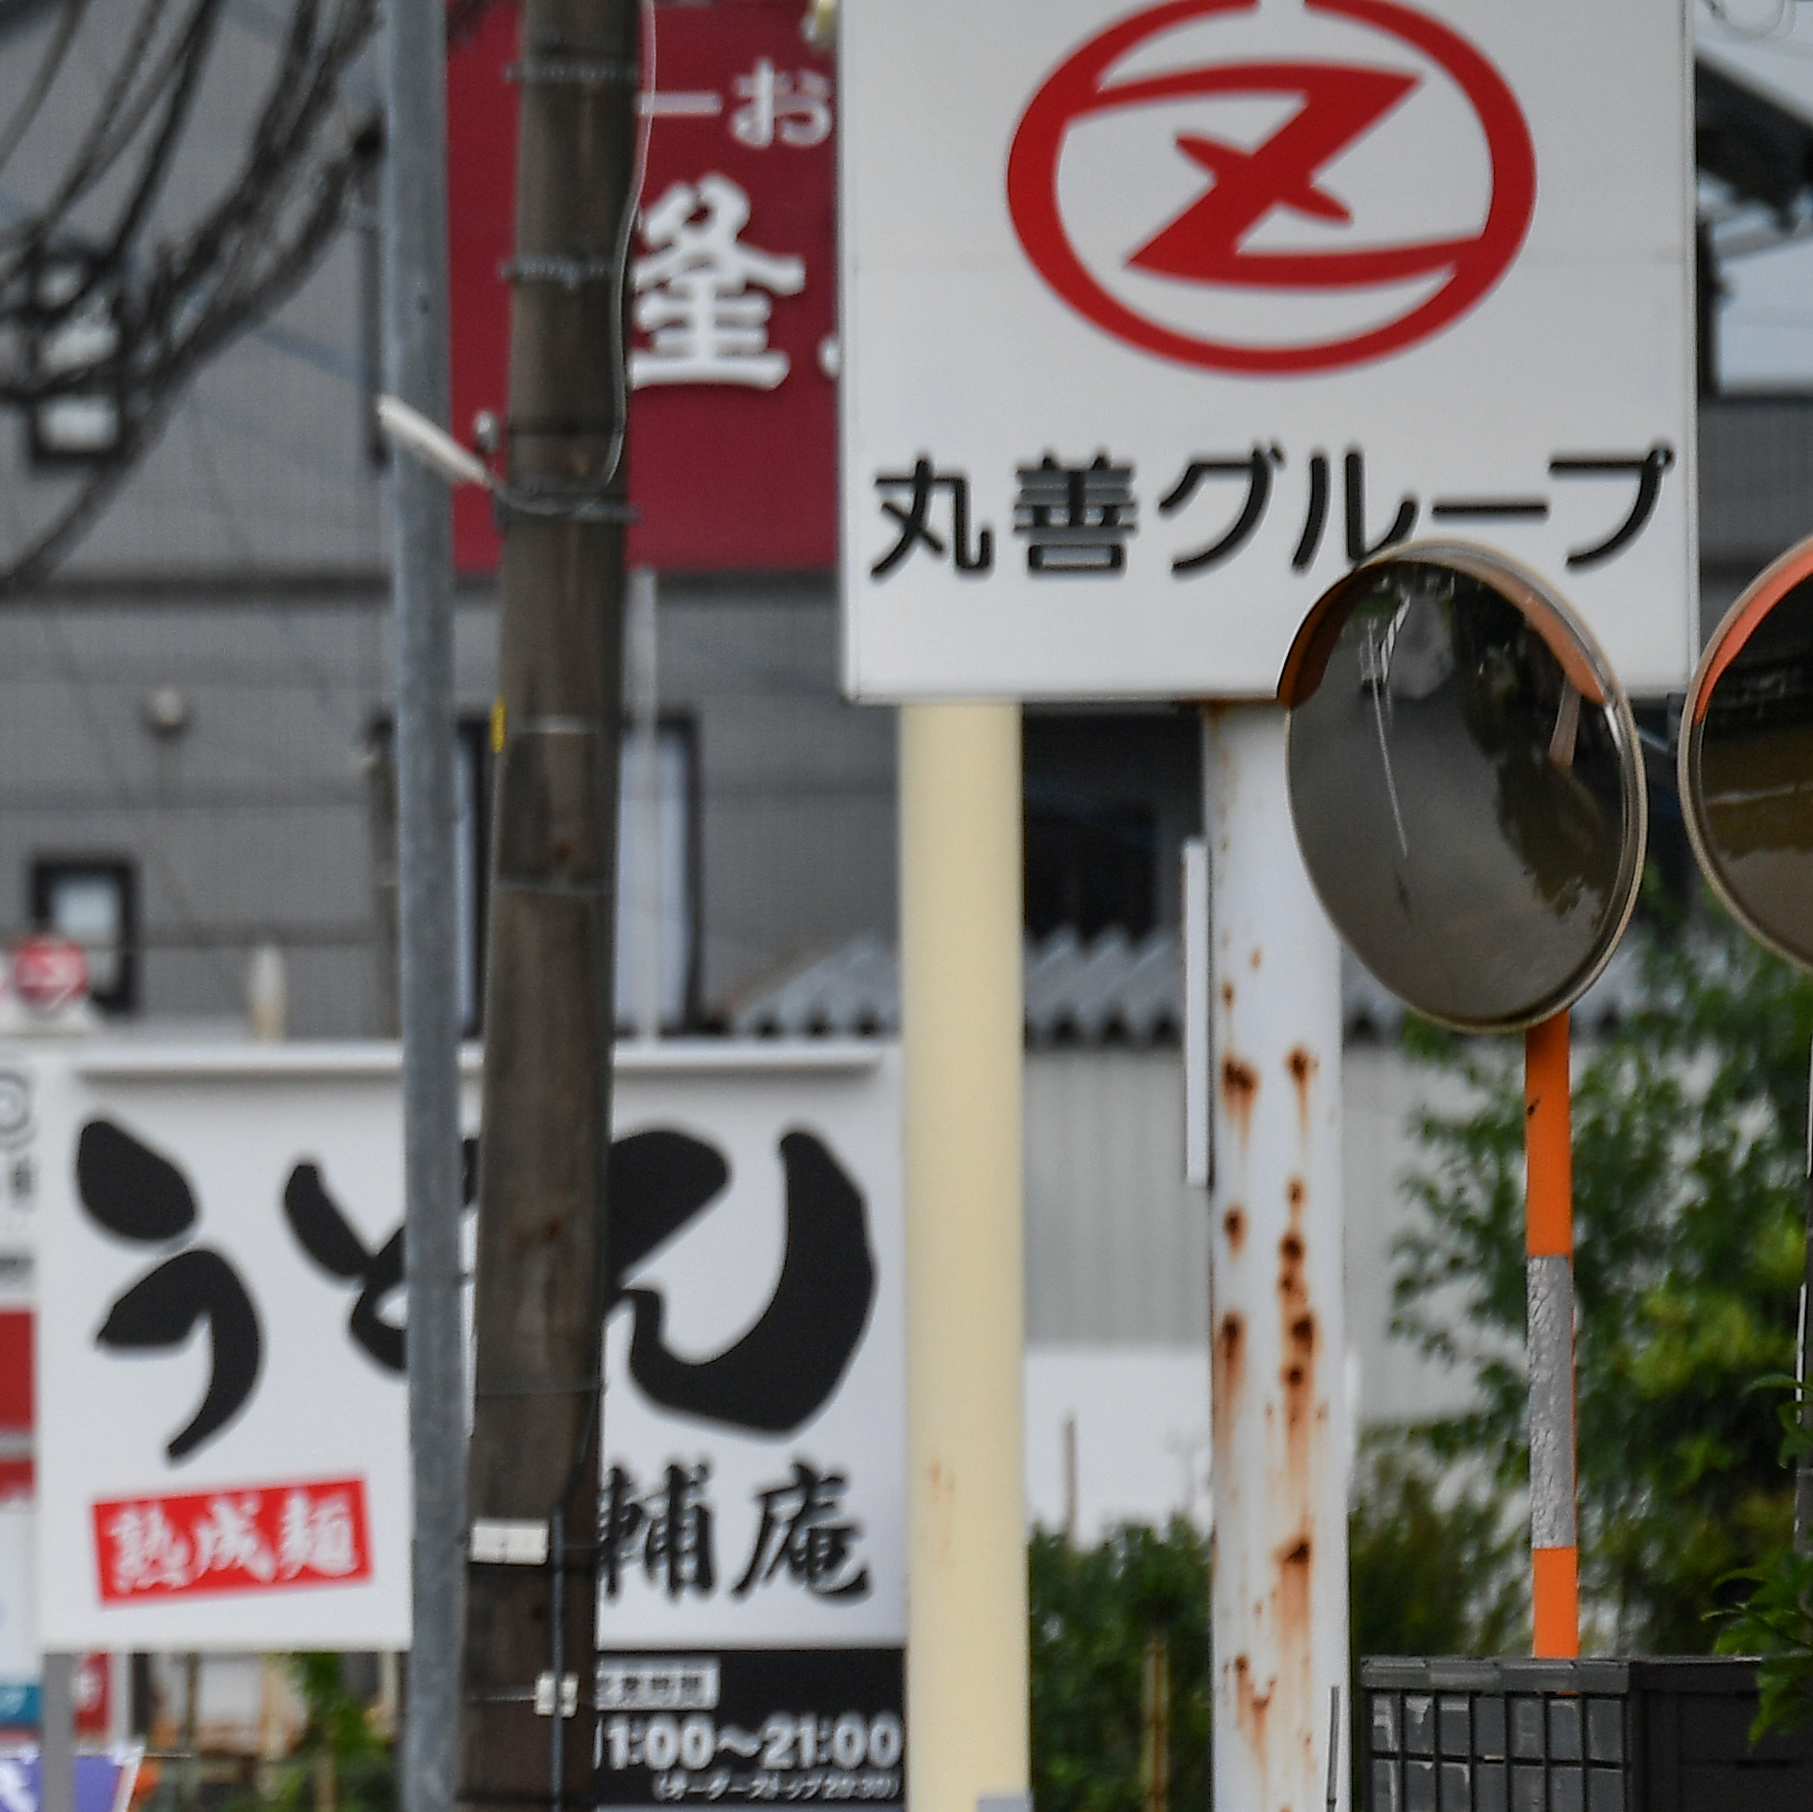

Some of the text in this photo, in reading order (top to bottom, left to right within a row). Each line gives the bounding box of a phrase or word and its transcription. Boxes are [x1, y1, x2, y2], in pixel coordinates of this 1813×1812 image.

[872, 448, 1675, 580] 丸善グループ
[111, 1492, 359, 1592] 熟成麺
